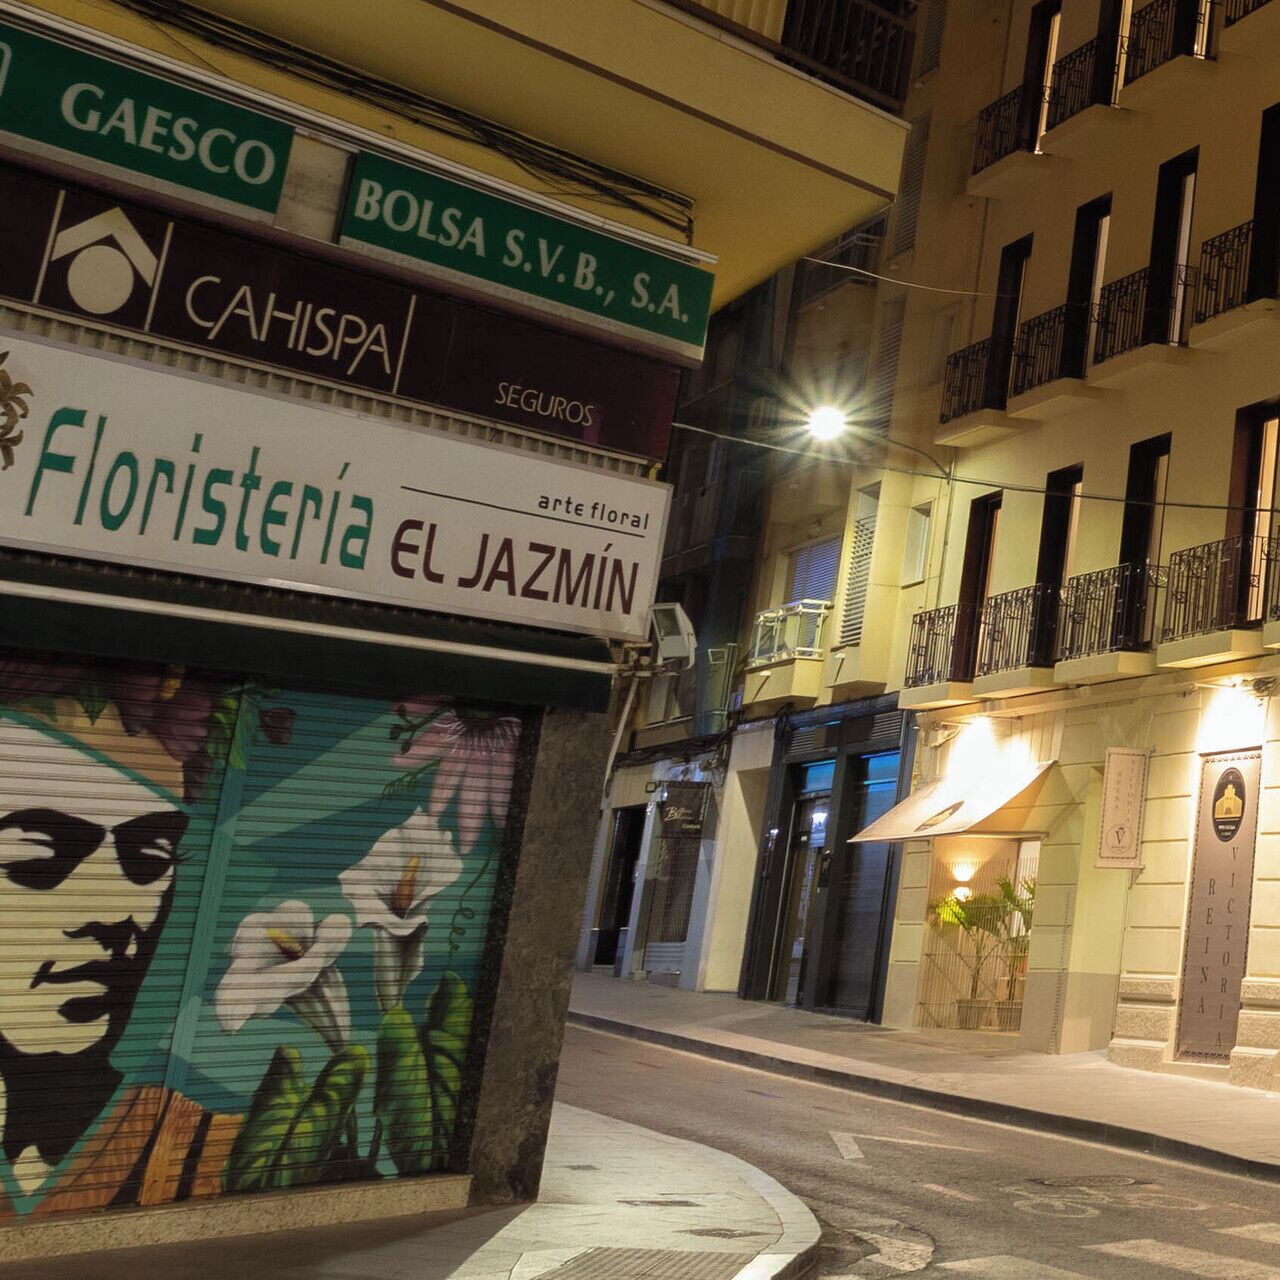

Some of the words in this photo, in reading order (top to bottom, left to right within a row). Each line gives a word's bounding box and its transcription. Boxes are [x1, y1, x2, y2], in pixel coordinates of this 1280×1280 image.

[59, 82, 276, 185] GAESCO
[353, 178, 486, 260] BOLSA
[502, 227, 616, 308] S.V.B.,
[629, 272, 690, 324] S.A.
[184, 274, 392, 378] CAHISPA
[493, 380, 596, 428] SEGUROS
[23, 405, 375, 571] Floristería
[537, 492, 584, 517] arte
[588, 498, 650, 531] floral
[390, 518, 445, 585] EL
[457, 522, 640, 615] JAZMÍN
[1197, 876, 1217, 1015] REINA
[1214, 846, 1241, 1049] VICTORIA
